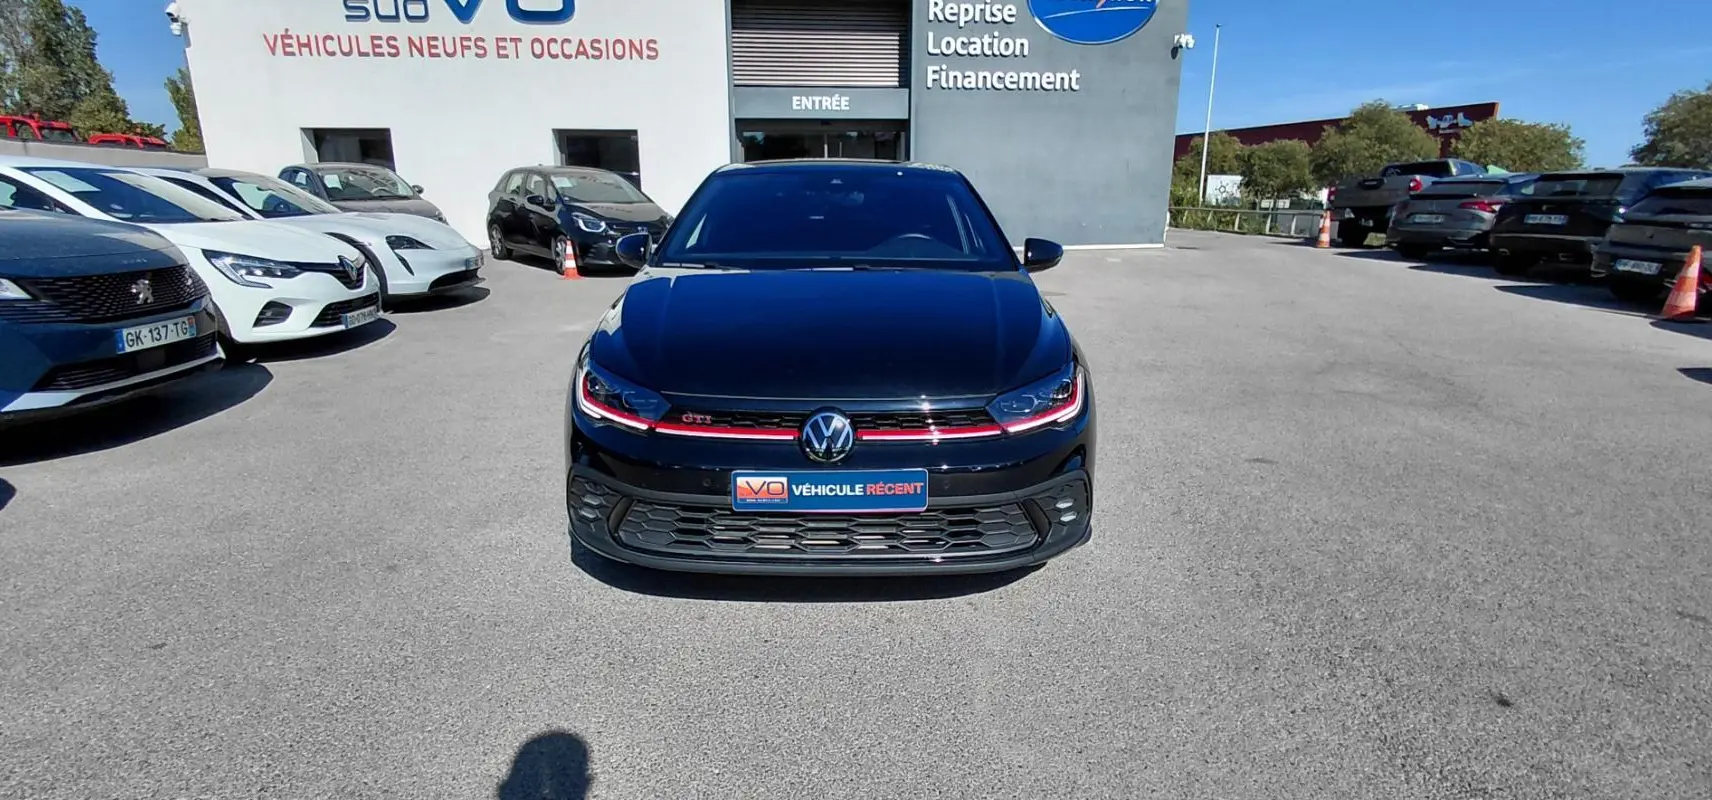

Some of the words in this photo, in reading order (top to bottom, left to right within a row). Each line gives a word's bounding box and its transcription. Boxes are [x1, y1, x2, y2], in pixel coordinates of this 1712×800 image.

[928, 0, 1016, 27] Reprise
[263, 29, 400, 58] VÉHICULES
[408, 36, 488, 59] NEUFS
[496, 37, 522, 59] ET
[531, 37, 659, 61] OCCASIONS
[926, 32, 1029, 56] Location
[926, 65, 1080, 90] Financement
[791, 93, 850, 111] ENTRÉE
[125, 320, 188, 348] GK-137-TG
[682, 411, 712, 424] GTI
[745, 480, 785, 496] VO
[792, 483, 864, 496] VÉHICULE
[866, 481, 924, 495] RÉCENT
